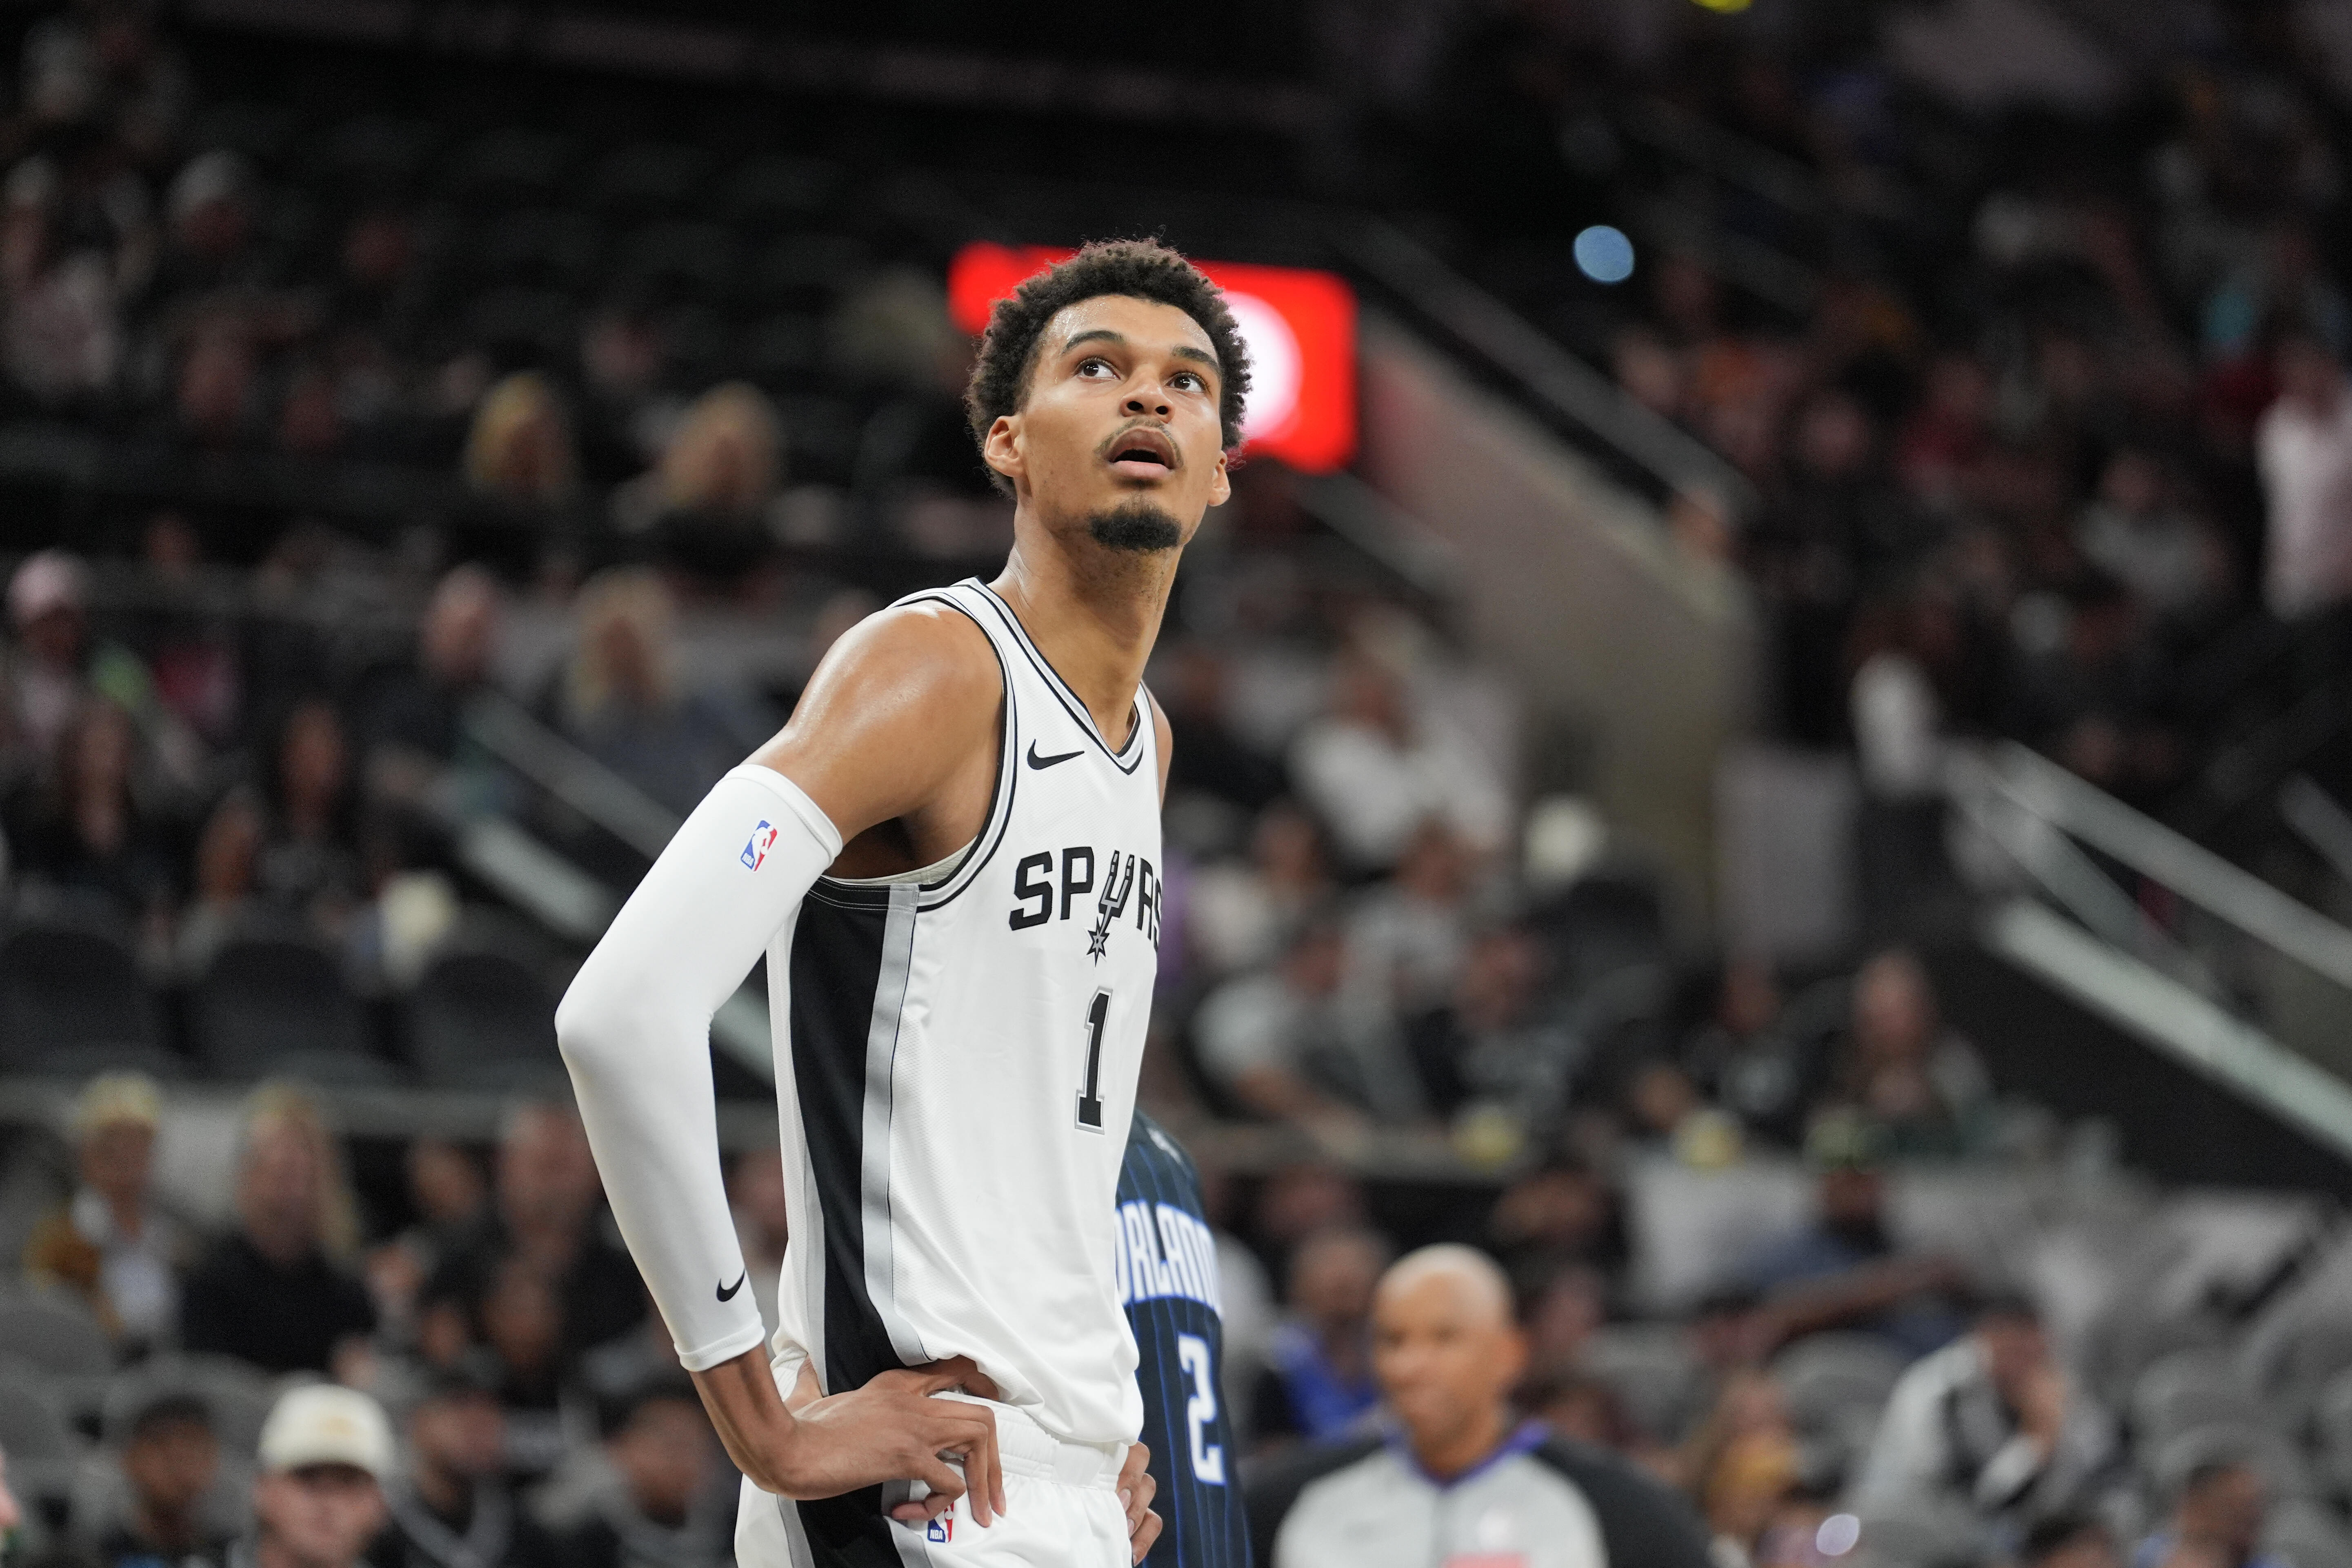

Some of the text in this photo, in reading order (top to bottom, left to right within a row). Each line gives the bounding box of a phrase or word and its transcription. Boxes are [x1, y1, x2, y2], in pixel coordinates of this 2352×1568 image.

[741, 852, 754, 867] NBA
[1075, 986, 1113, 1135] 1
[1178, 1330, 1225, 1485] 2
[929, 1529, 943, 1540] NBA
